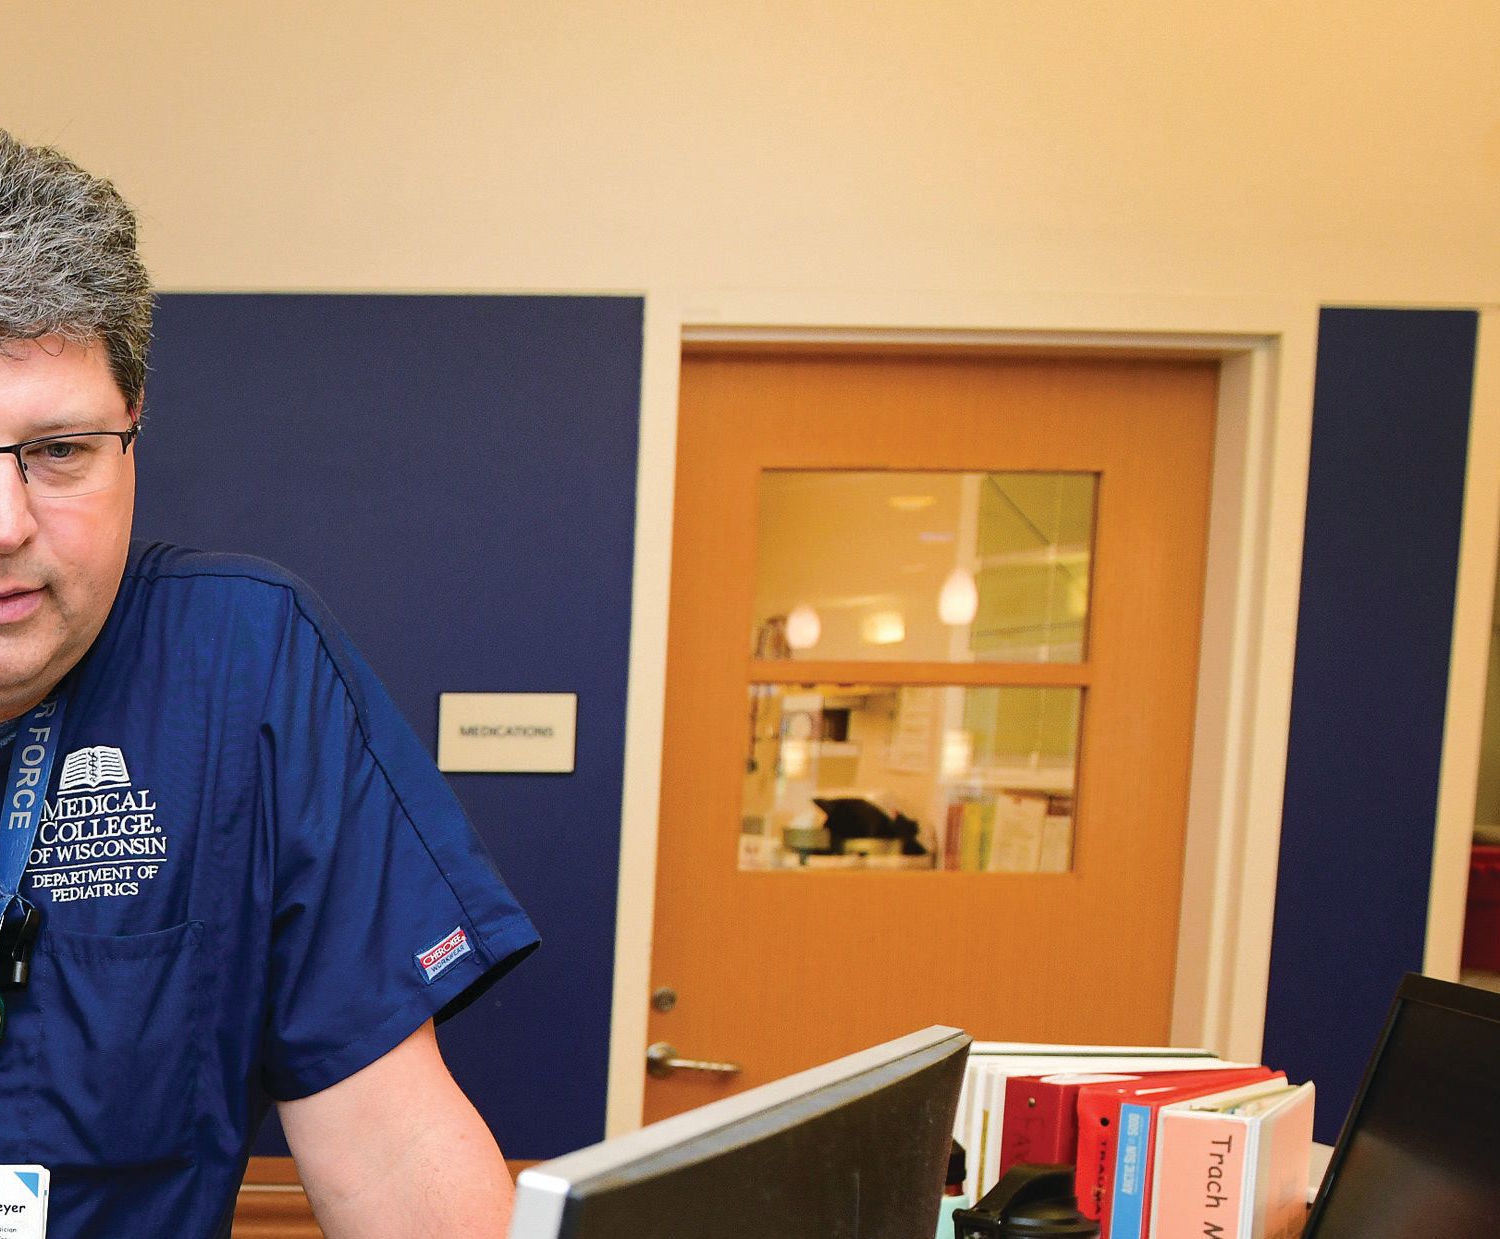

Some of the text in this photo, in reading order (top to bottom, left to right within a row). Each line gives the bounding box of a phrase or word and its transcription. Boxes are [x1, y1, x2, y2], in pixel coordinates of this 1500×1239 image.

[459, 726, 554, 737] MEDICATIONS
[8, 727, 51, 830] FORCE
[41, 790, 156, 822] MEDICAL
[28, 837, 167, 865] OF WISCONSIN
[32, 865, 158, 889] DEPARTMENT OF
[51, 882, 139, 902] PEDIATRICS
[423, 933, 464, 965] CHEROKEE
[431, 944, 465, 972] WORKWEAR
[1205, 1134, 1233, 1208] Trach
